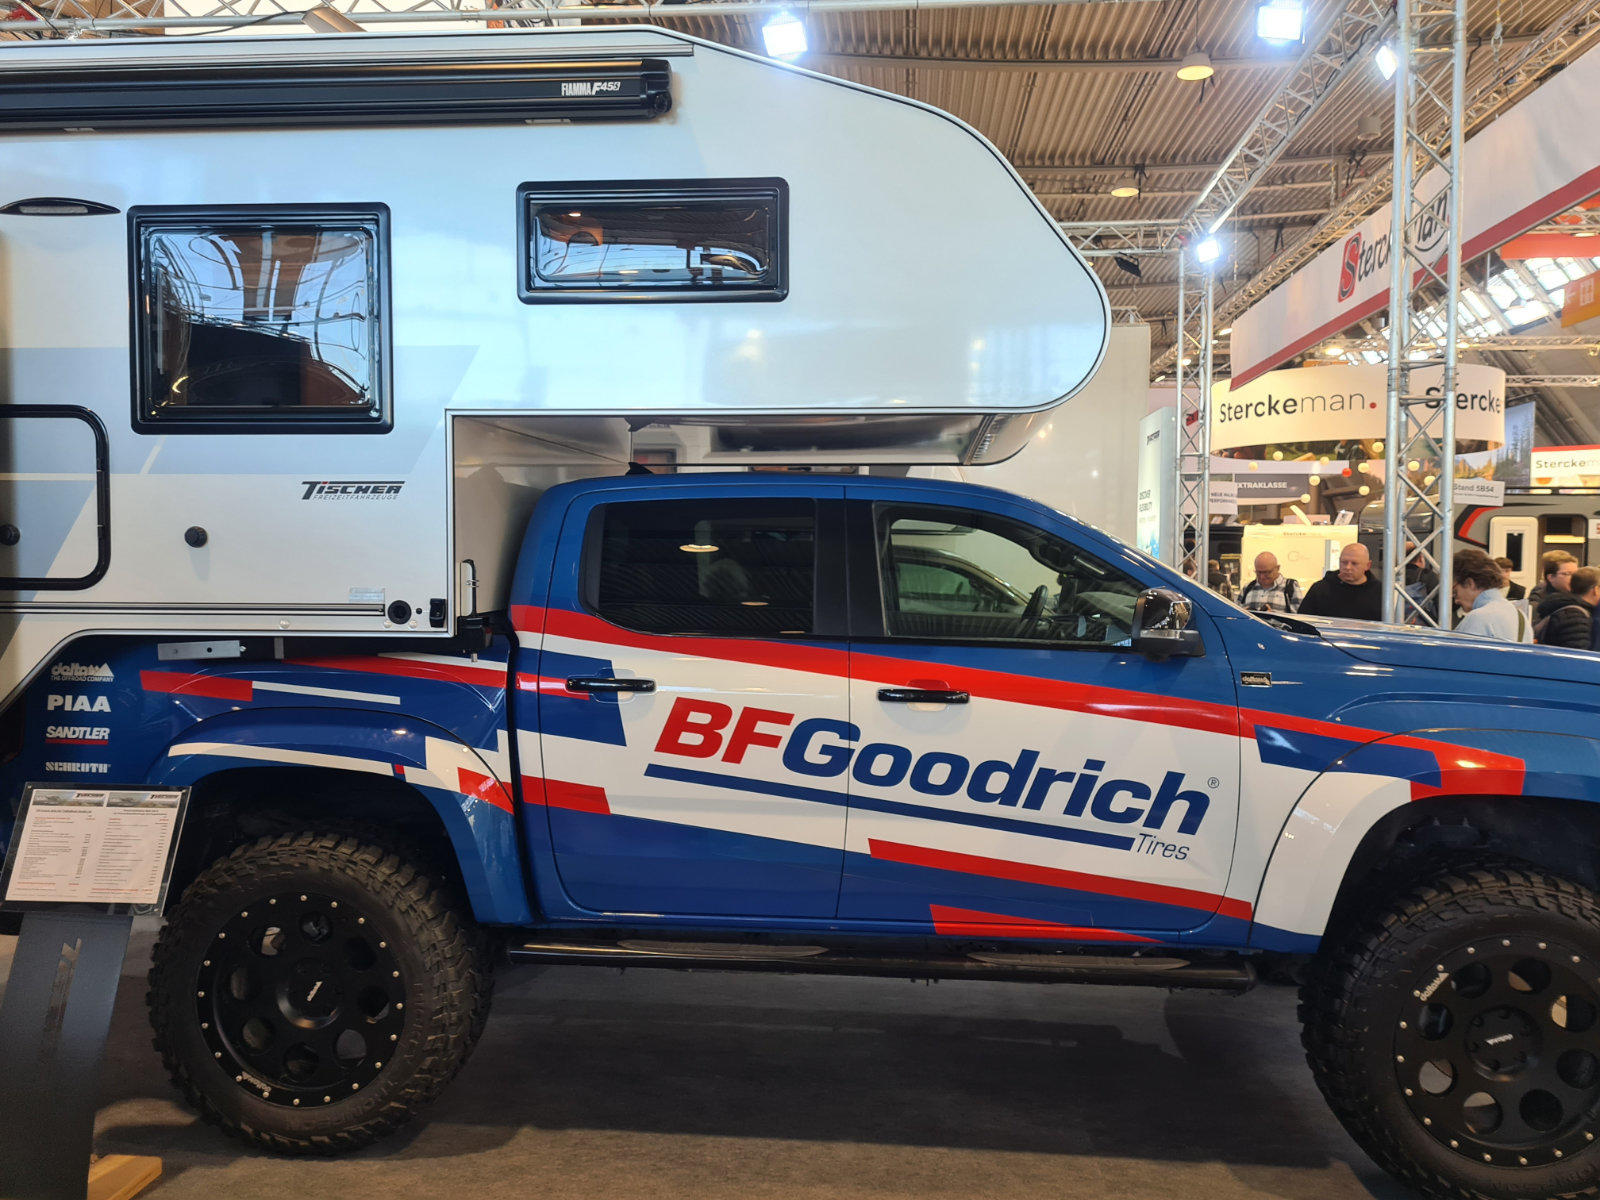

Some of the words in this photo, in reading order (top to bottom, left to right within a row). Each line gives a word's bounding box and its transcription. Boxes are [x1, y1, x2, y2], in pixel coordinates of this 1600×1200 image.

[561, 82, 591, 96] FIAMMA
[1425, 387, 1502, 414] Sercke
[302, 481, 405, 500] TISCHER
[1237, 481, 1288, 489] XTRAKLASSE
[47, 694, 112, 712] PIAA
[45, 726, 110, 740] SANDTLER
[654, 696, 1210, 836] BFGoodrich
[1137, 833, 1190, 860] Tires
